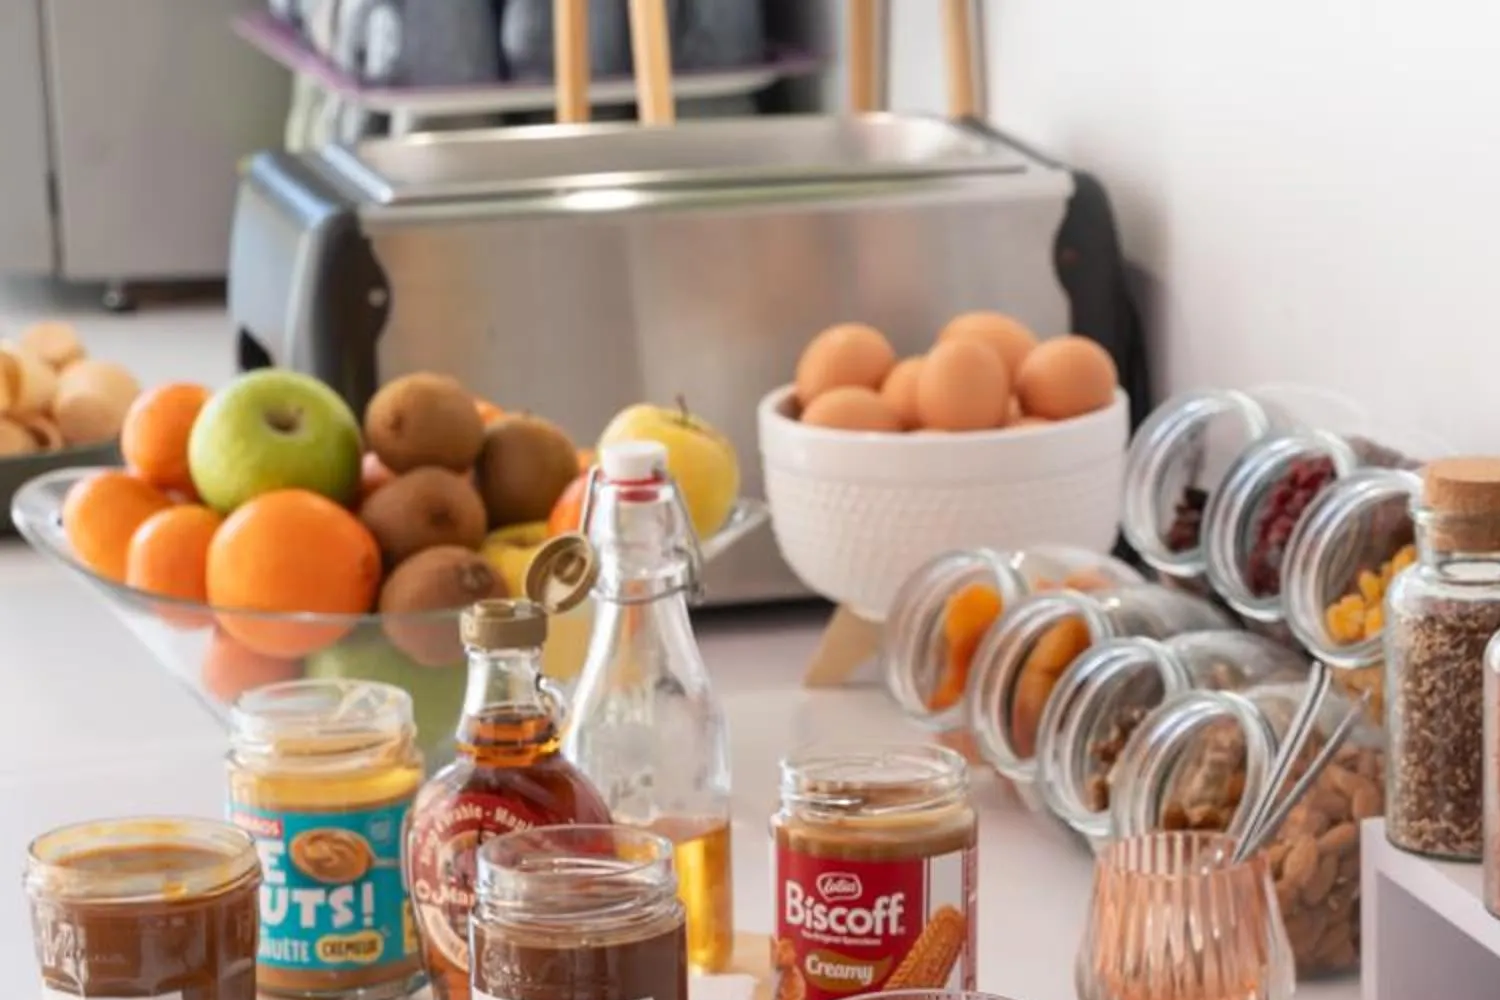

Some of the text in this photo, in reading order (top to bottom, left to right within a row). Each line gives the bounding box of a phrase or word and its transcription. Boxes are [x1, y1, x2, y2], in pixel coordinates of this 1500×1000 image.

[259, 881, 375, 929] UTS!
[785, 879, 905, 937] Biscoff
[805, 953, 874, 986] Creamy
